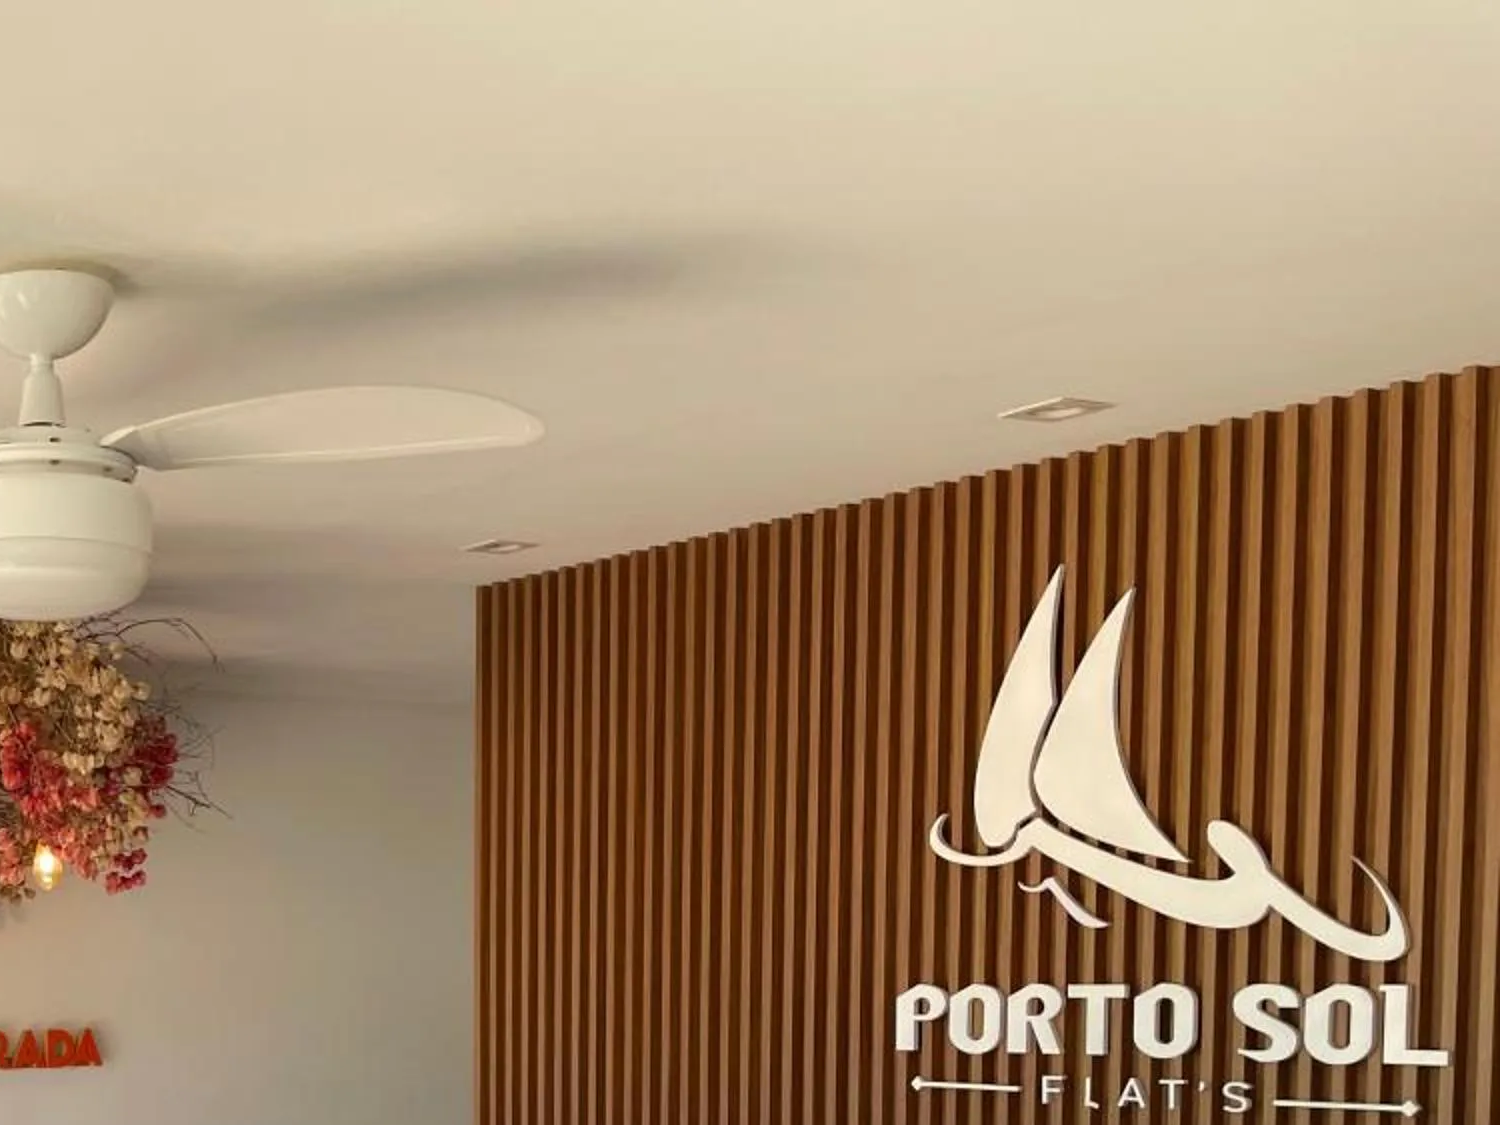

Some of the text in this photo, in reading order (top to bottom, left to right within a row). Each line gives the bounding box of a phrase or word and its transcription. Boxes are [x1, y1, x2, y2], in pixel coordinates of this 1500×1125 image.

[895, 982, 1450, 1066] PORTO SOL
[1041, 1075, 1252, 1113] FLAT'S
